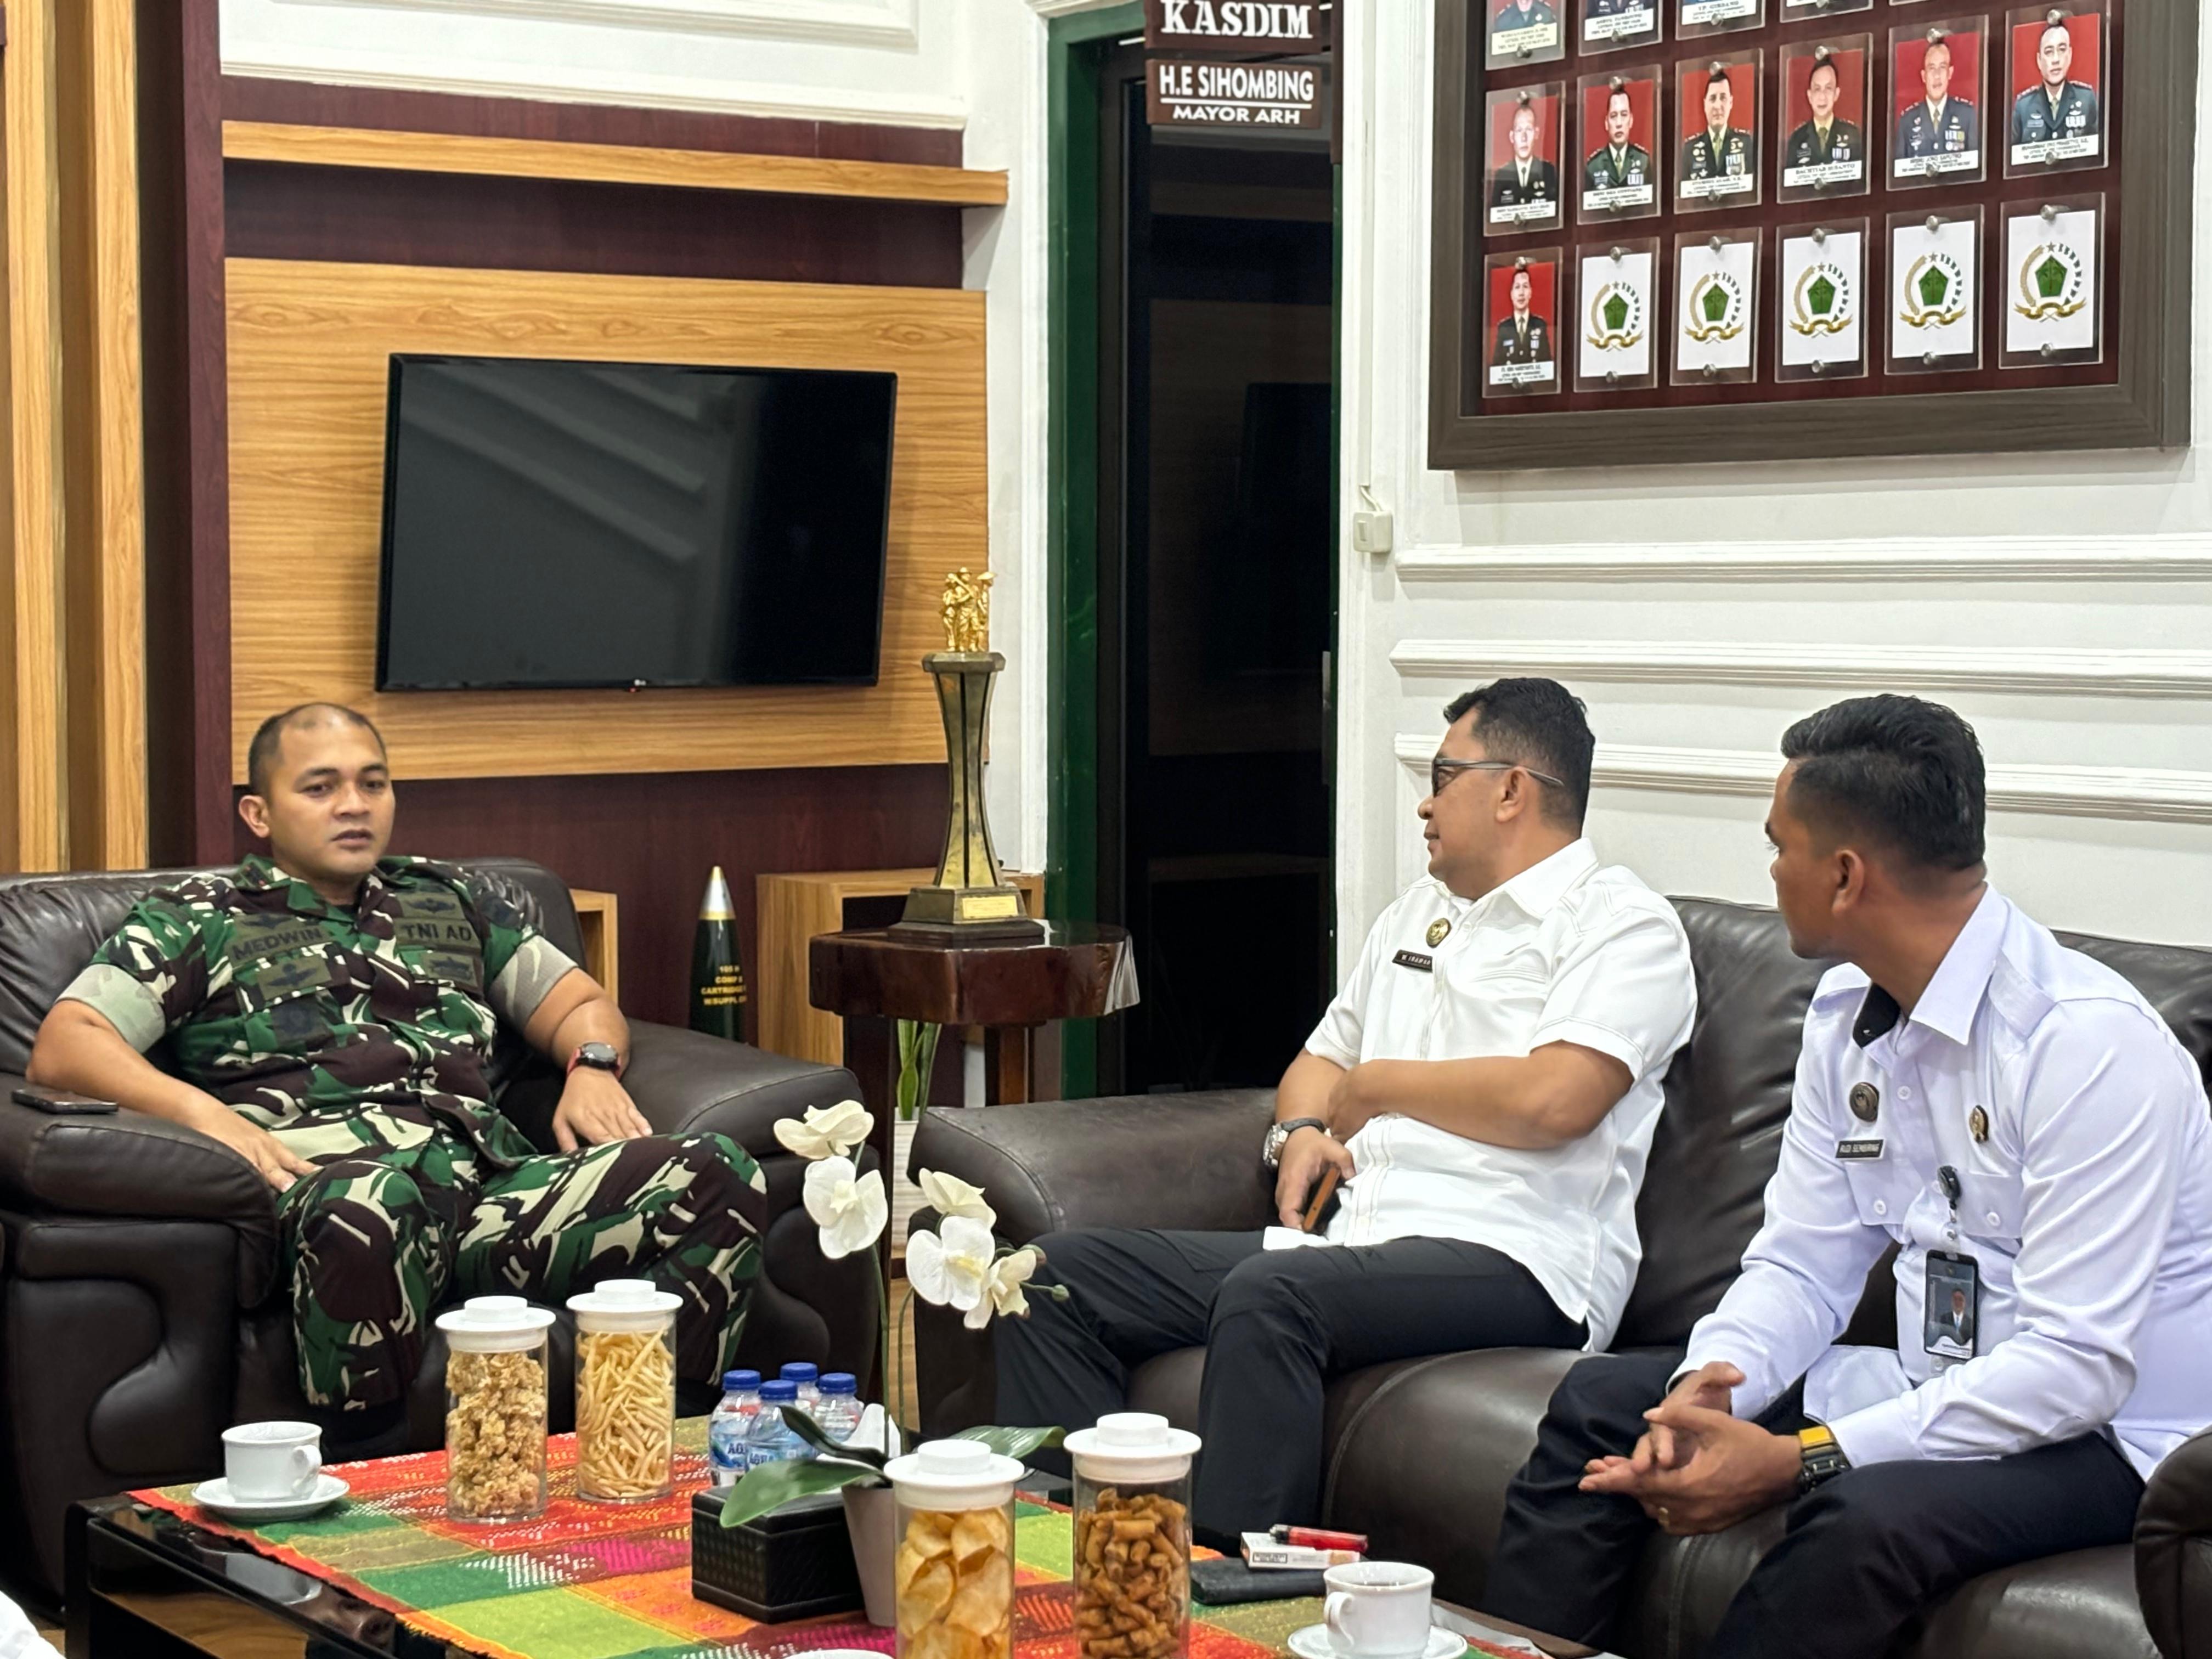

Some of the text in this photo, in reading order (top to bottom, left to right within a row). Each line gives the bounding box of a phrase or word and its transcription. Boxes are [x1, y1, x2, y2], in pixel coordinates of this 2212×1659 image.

[1160, 0, 1314, 39] KASDIM
[1159, 65, 1314, 101] H.E SIHOMBING
[1172, 105, 1301, 125] MAYOR ARH
[232, 928, 323, 960] MEDWIN
[401, 923, 472, 941] TNI AD
